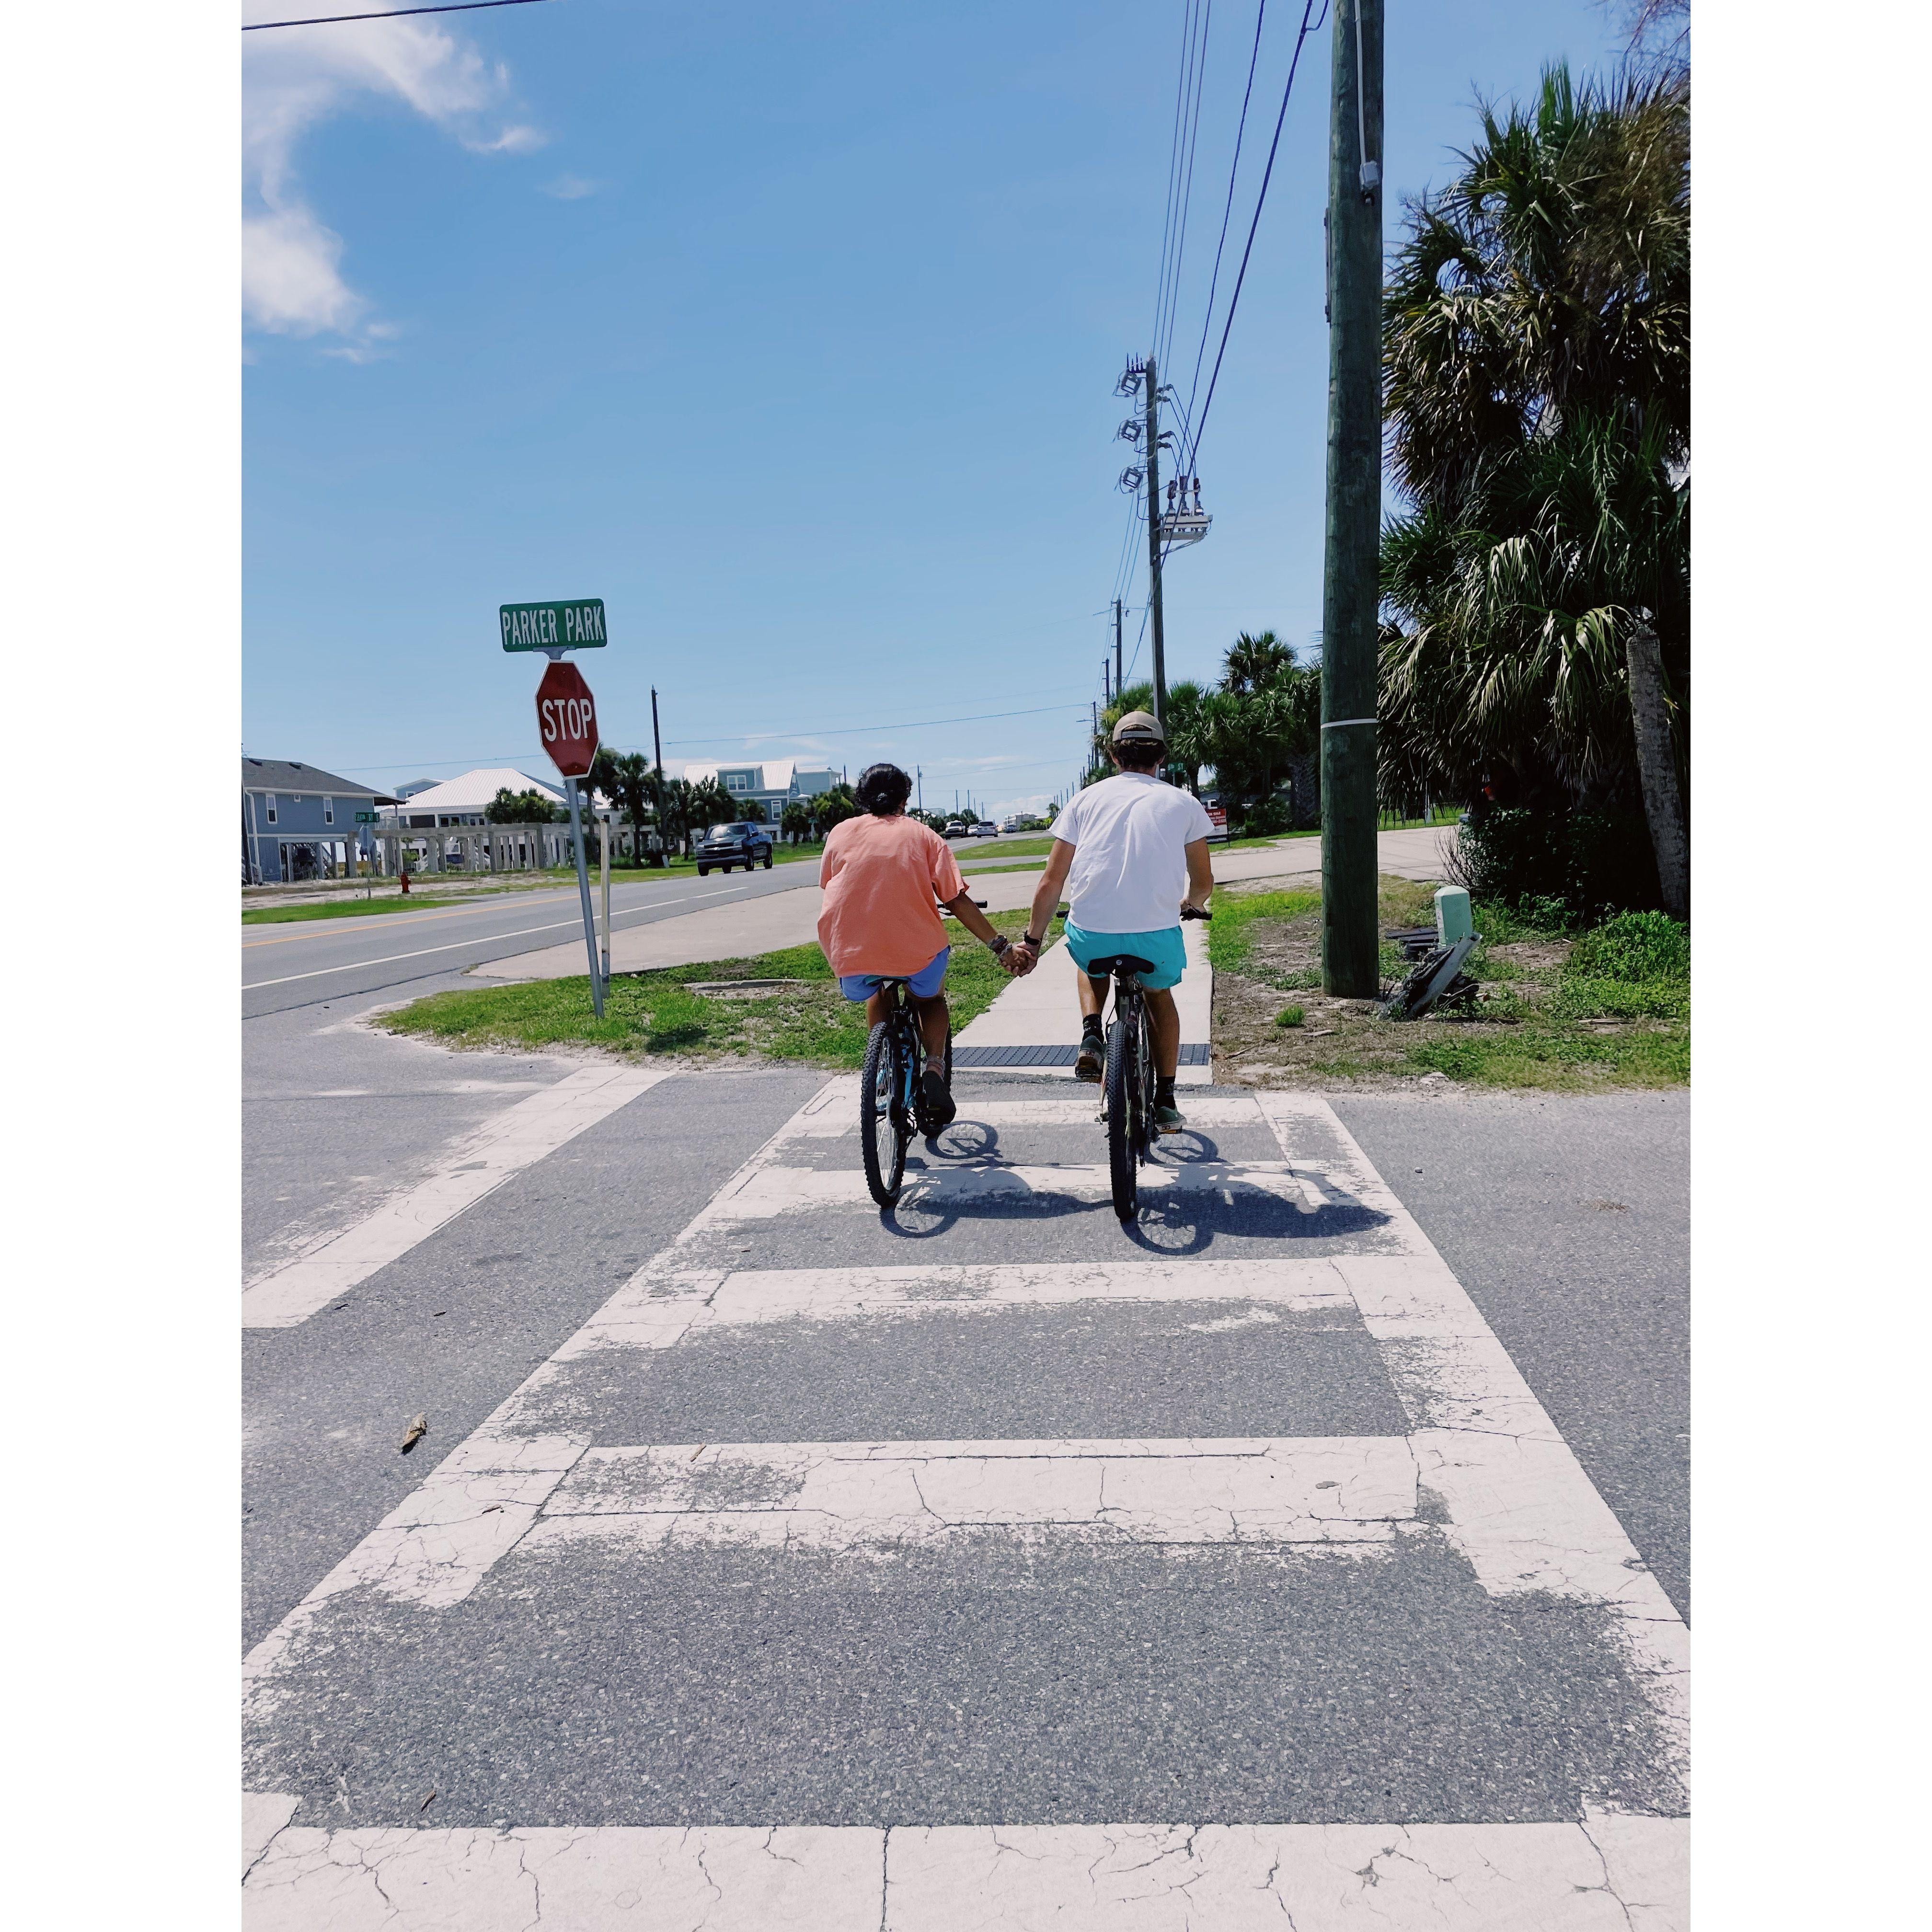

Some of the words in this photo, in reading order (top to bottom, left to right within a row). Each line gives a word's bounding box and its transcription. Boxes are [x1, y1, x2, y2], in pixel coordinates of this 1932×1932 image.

[502, 609, 558, 645] PARKER
[565, 606, 604, 641] PARK
[542, 698, 592, 741] STOP
